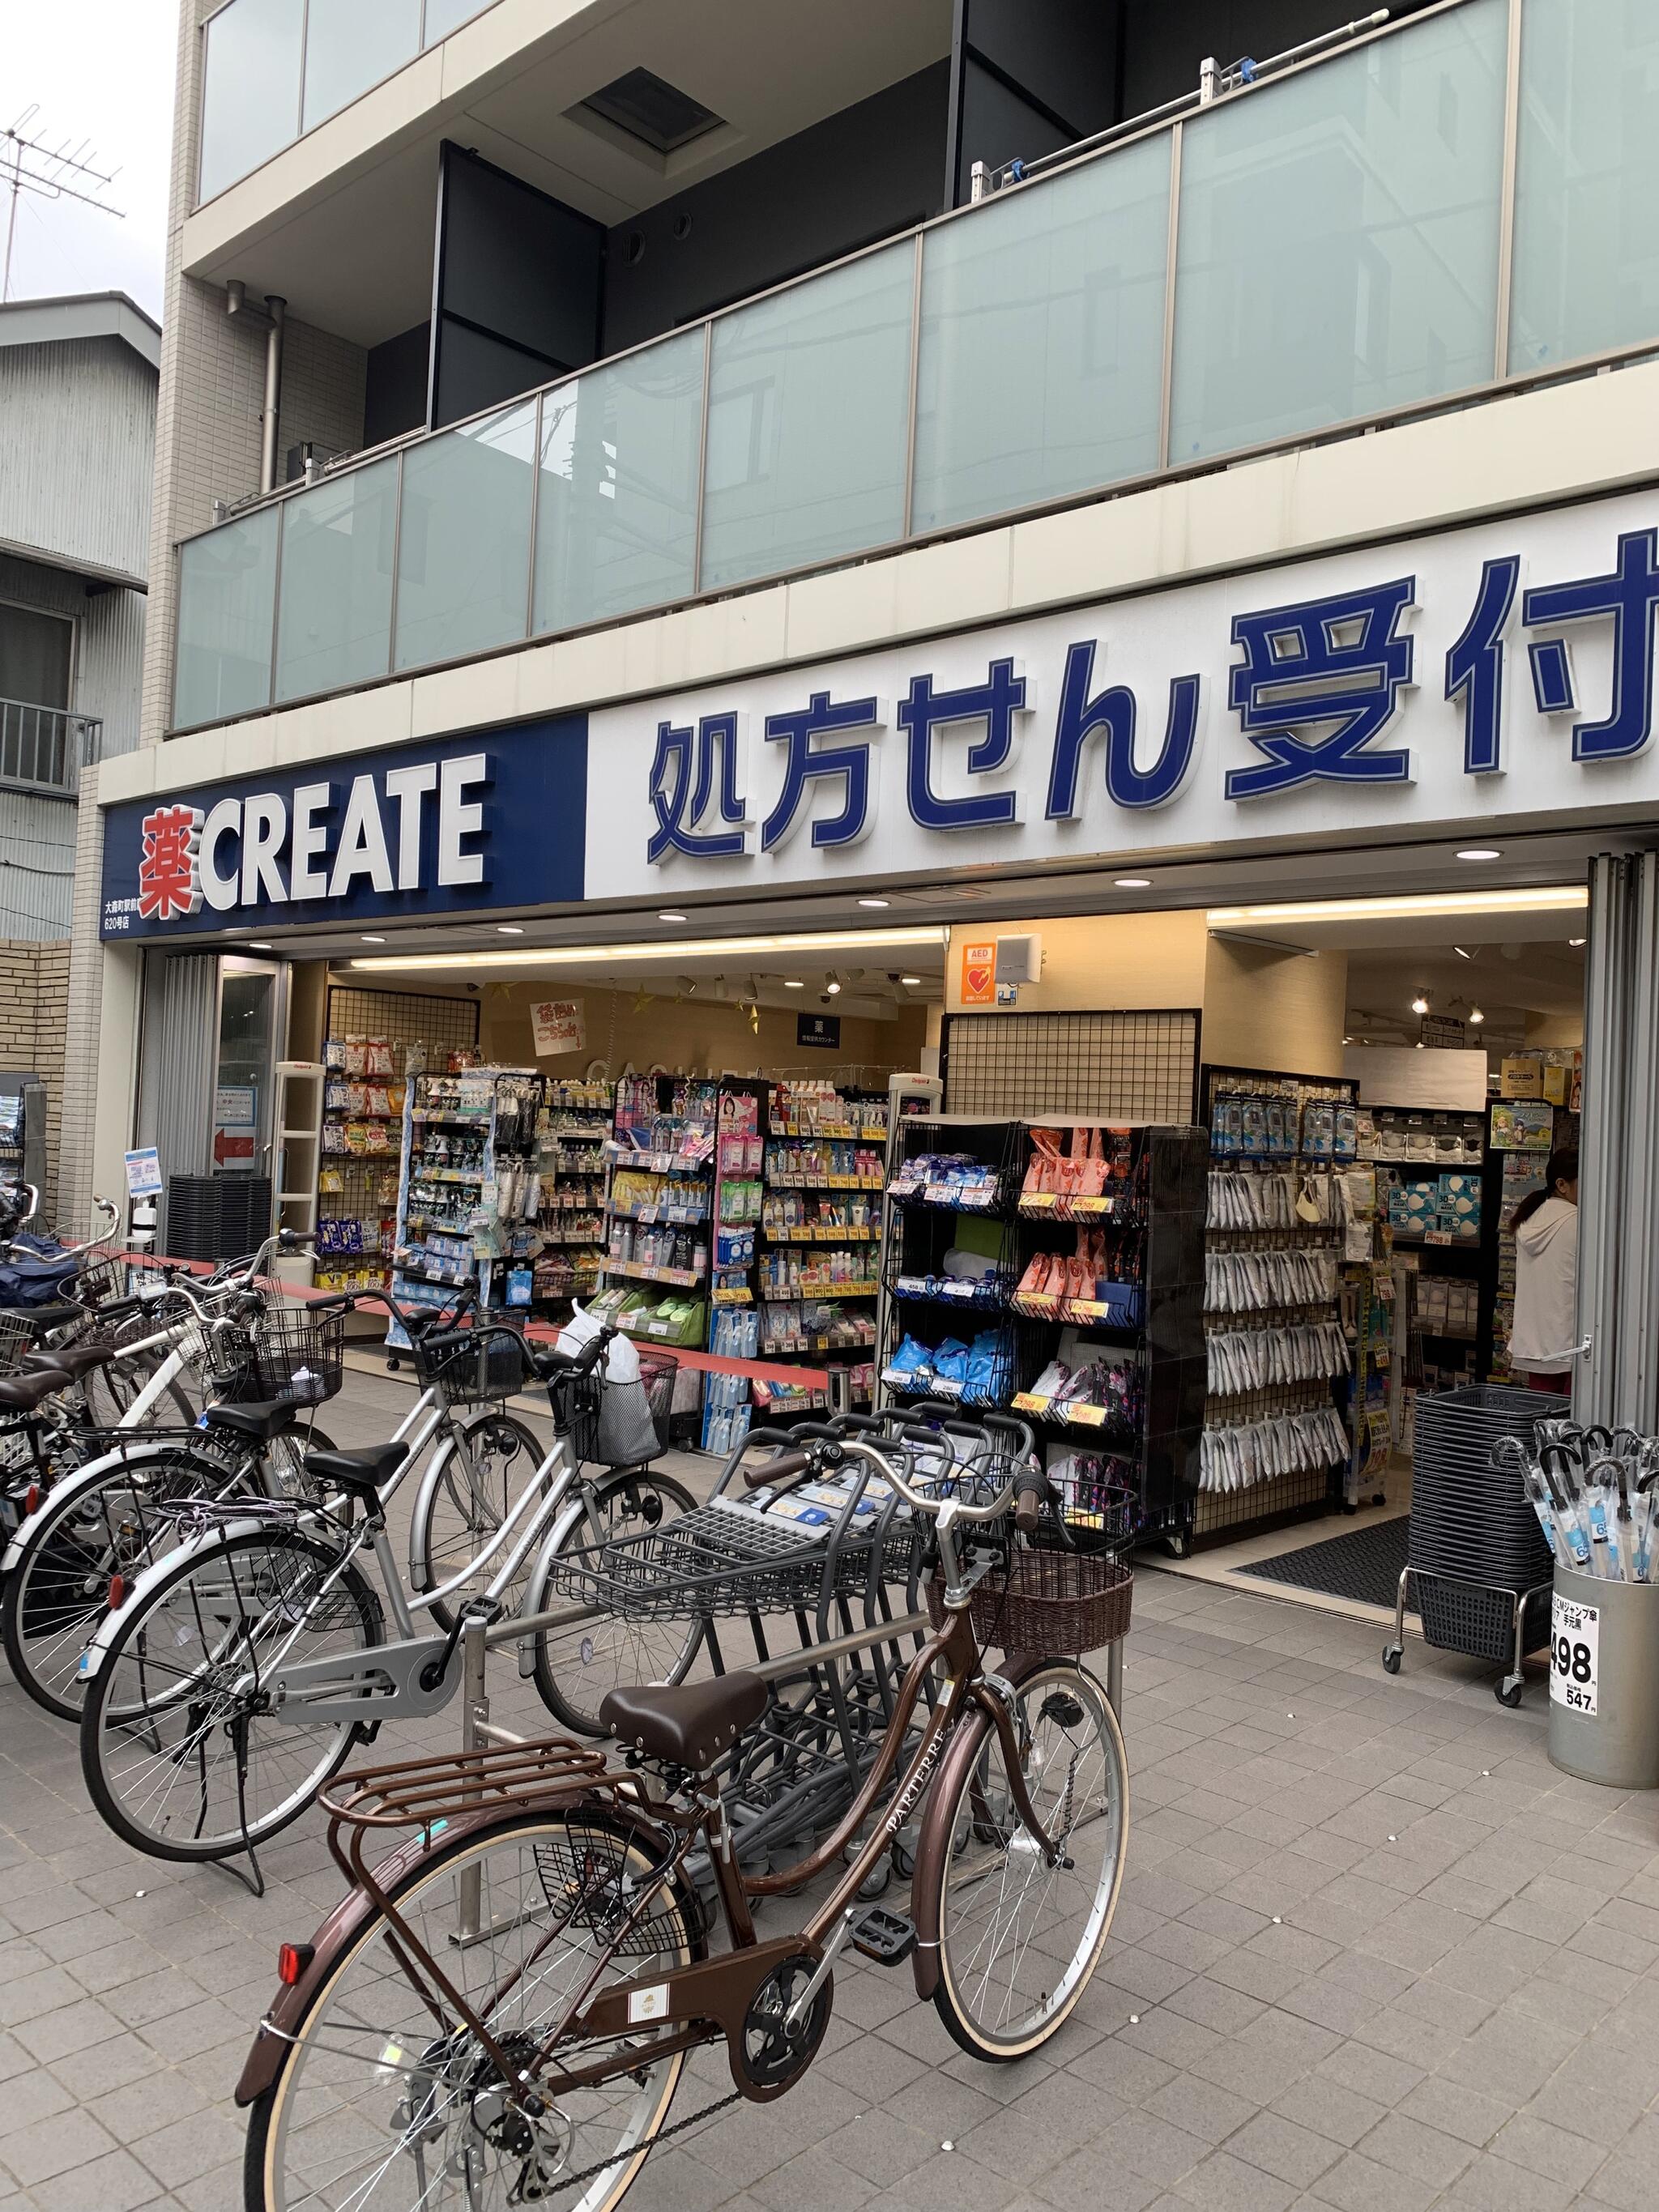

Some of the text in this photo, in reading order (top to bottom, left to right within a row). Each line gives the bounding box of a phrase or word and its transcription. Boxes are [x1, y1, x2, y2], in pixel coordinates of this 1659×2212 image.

[646, 528, 1659, 866] 処方せん受付
[199, 752, 488, 911] CREATE
[104, 897, 140, 914] 大森町駅前
[104, 915, 130, 930] 620号店
[971, 948, 988, 957] AED
[1551, 1631, 1591, 1683] 498
[1567, 1689, 1592, 1711] 547
[885, 1728, 945, 1832] PARTERRE
